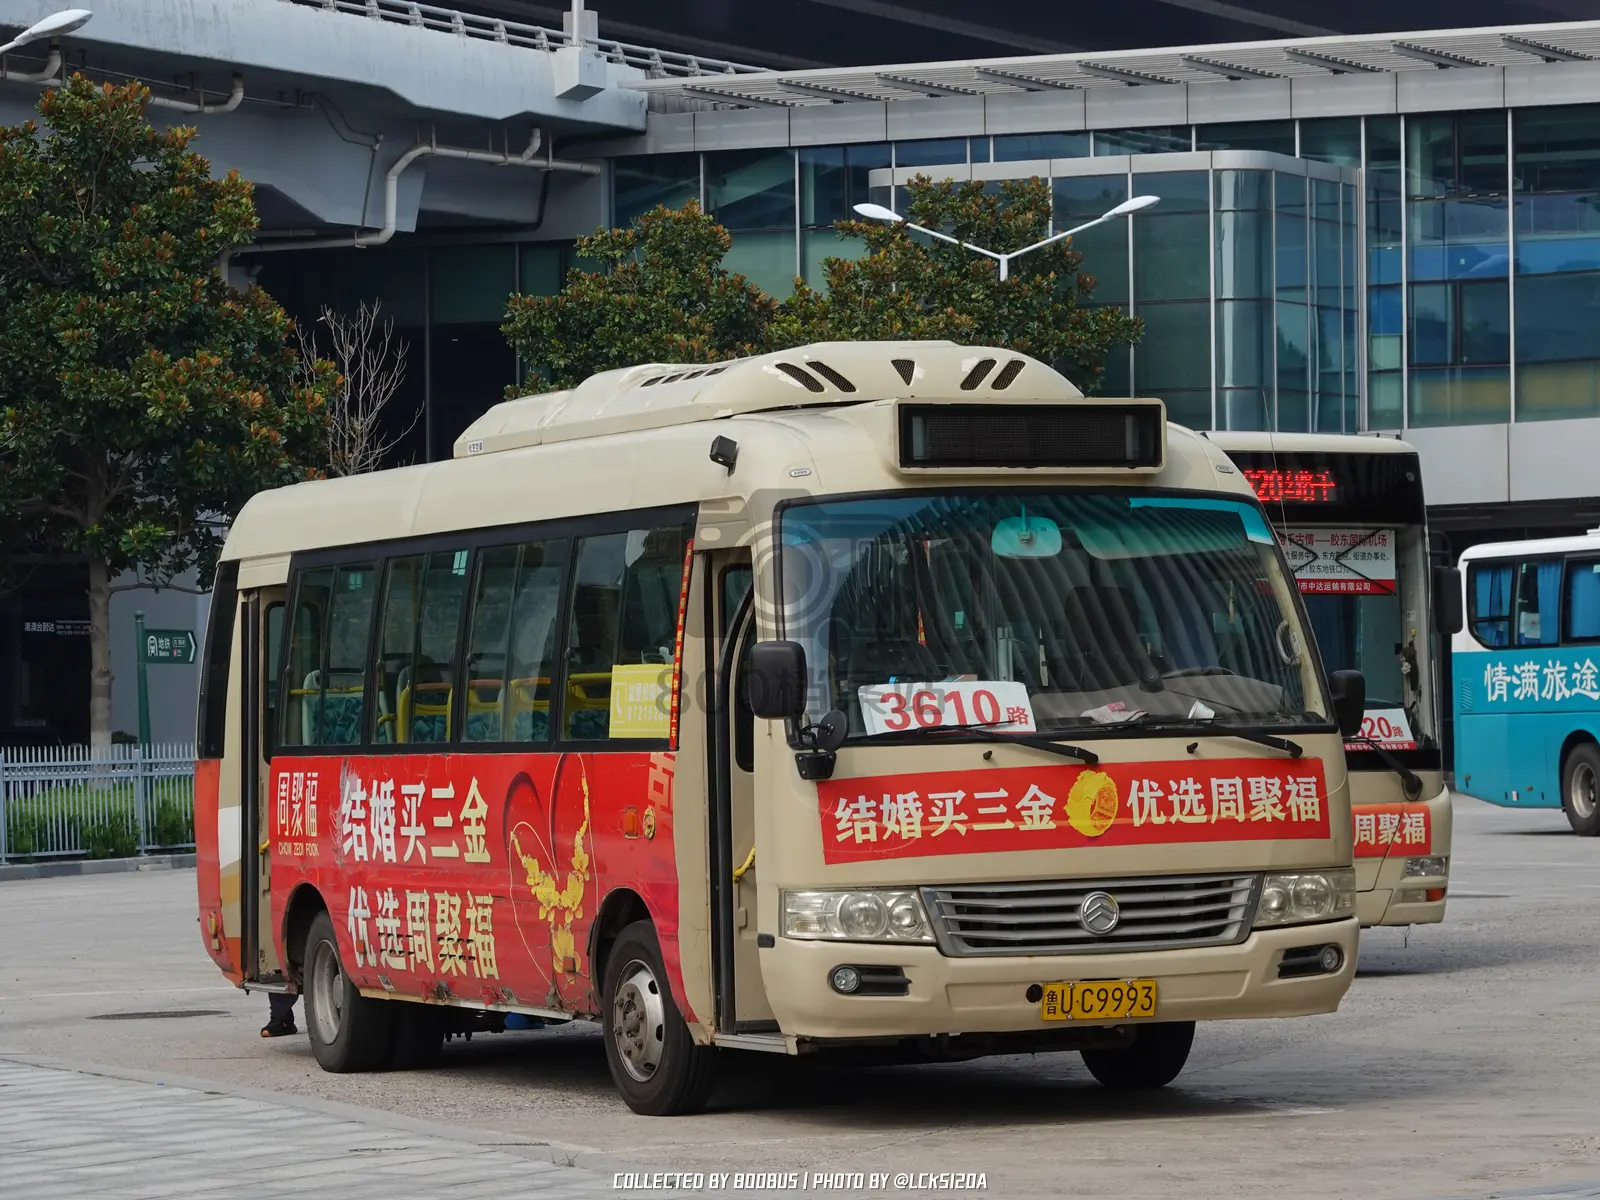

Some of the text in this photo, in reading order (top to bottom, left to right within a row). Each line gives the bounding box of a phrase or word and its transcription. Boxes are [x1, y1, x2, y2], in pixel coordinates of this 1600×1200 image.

[1298, 581, 1371, 592] 市中达运输有限公司
[1484, 658, 1600, 702] 情满旅途
[277, 772, 318, 837] 周聚福
[341, 775, 492, 865] 结婚买三金
[835, 774, 1322, 845] 结婚买三金 优选周聚福
[1354, 812, 1426, 846] 周聚福
[347, 885, 500, 981] 优选周聚福
